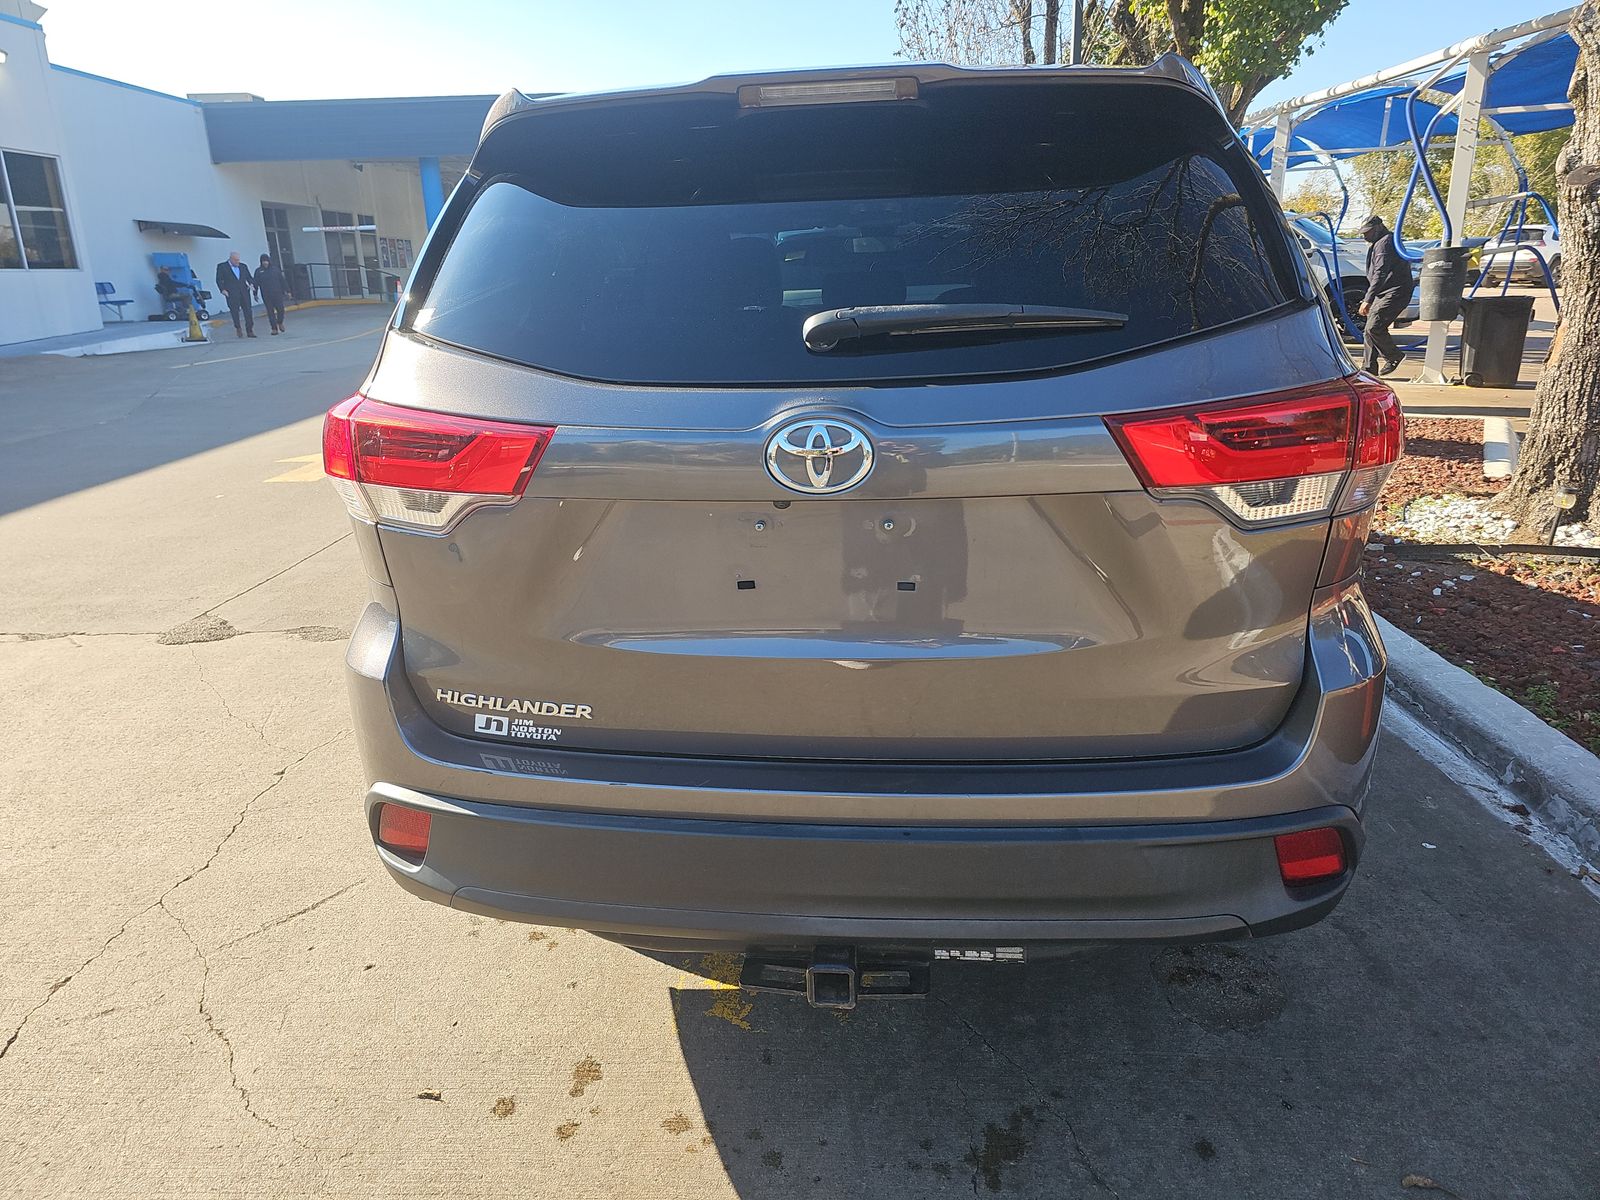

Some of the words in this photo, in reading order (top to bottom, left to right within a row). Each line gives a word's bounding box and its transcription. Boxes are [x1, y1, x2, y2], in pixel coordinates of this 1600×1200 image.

[436, 688, 593, 720] HIGHLANDER
[512, 718, 533, 727] JIM
[511, 725, 562, 735] NORTON
[511, 731, 557, 741] TOYOTA
